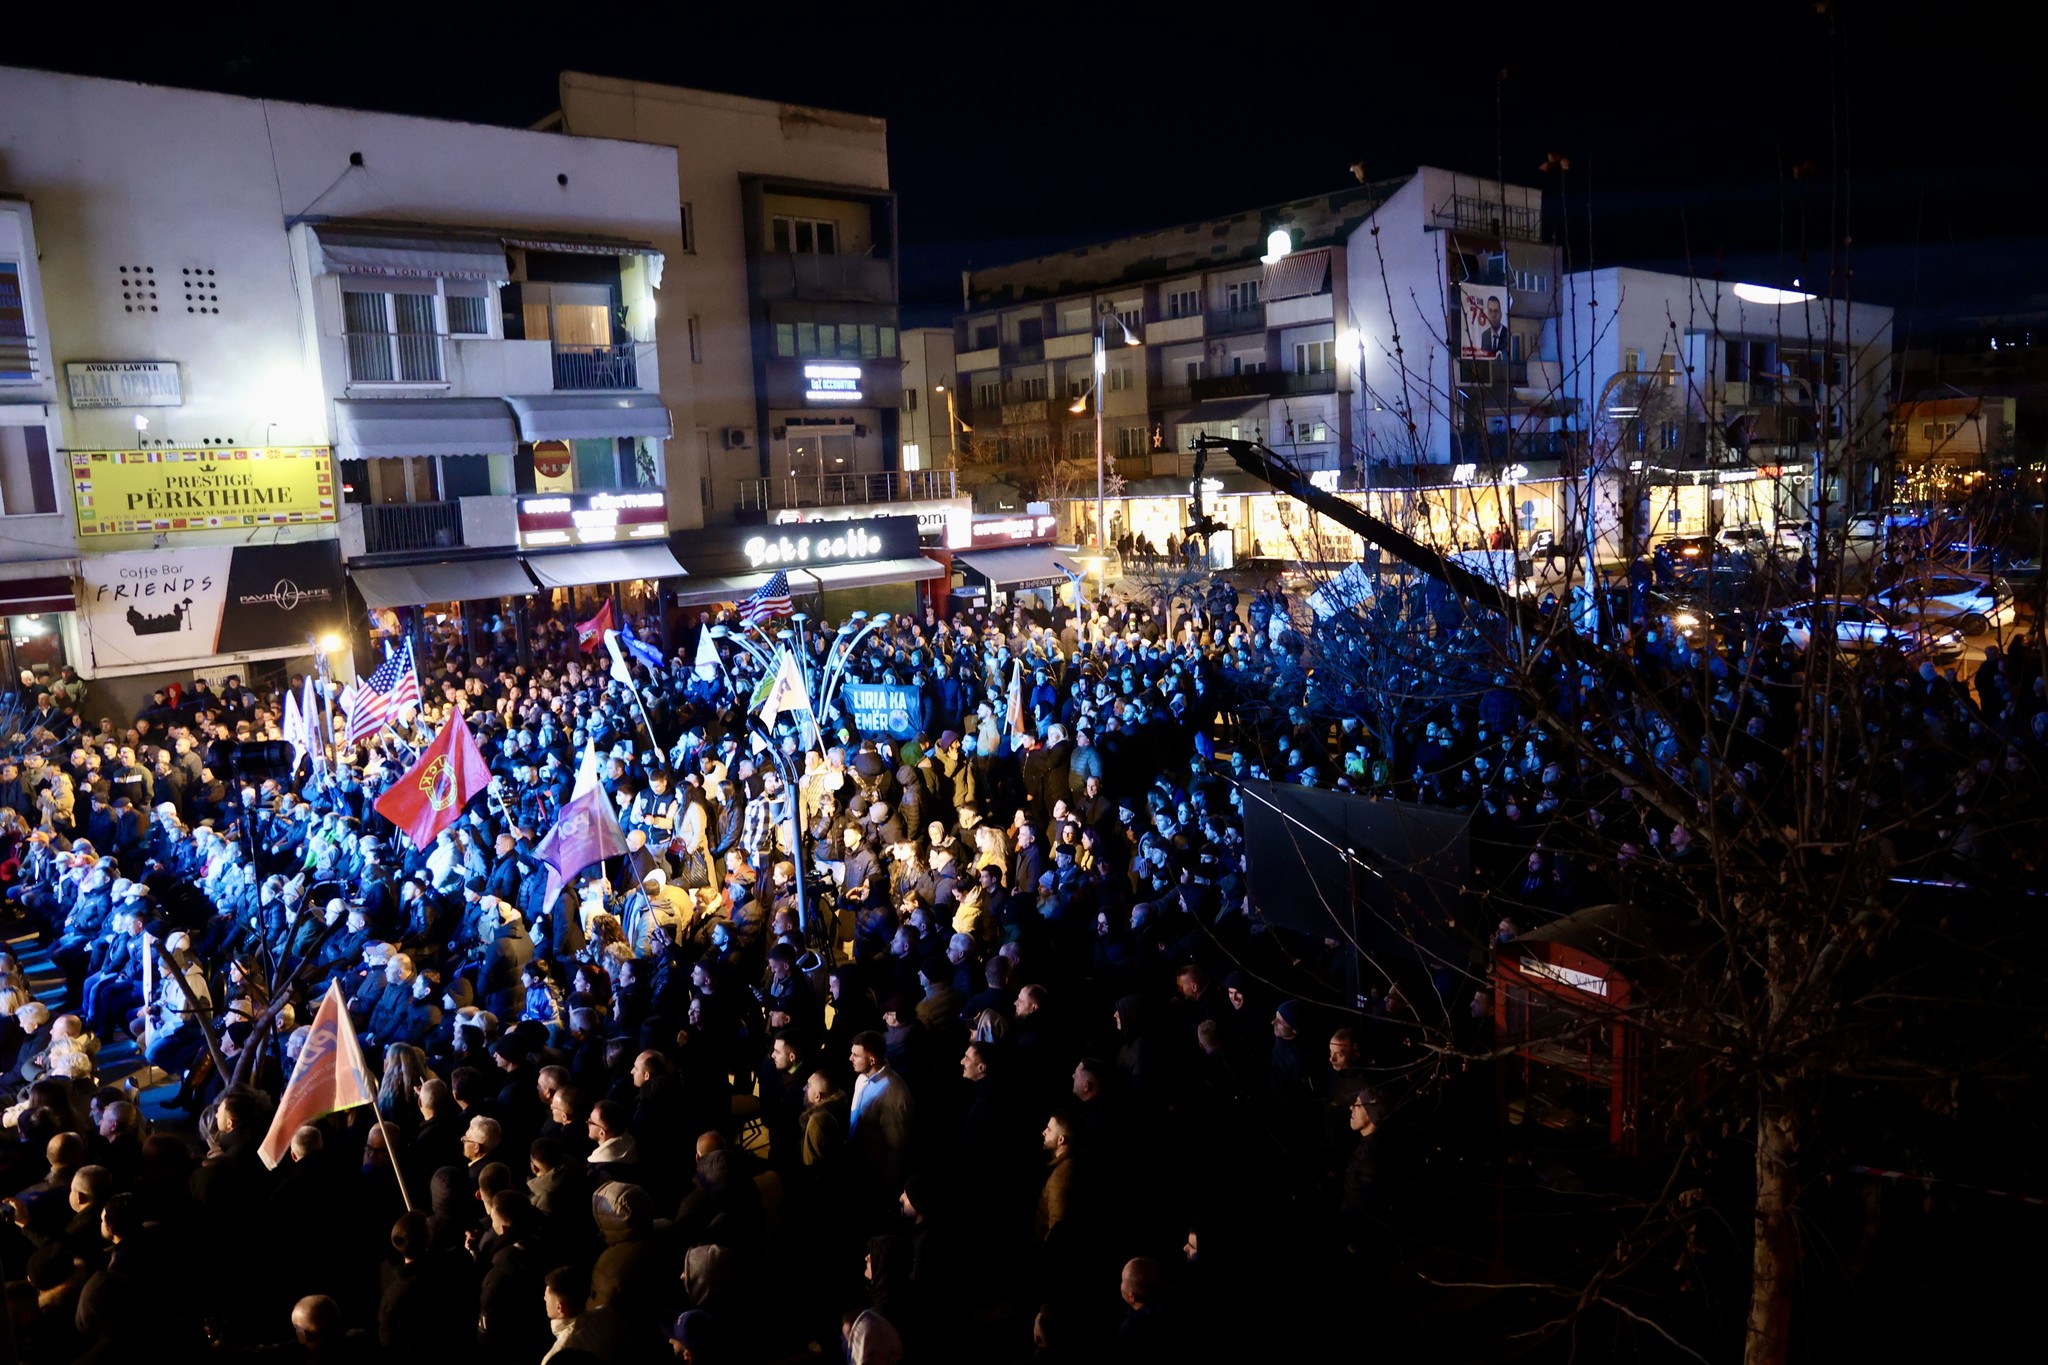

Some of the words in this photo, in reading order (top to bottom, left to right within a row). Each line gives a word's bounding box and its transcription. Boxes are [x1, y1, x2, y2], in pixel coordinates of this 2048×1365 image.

[348, 266, 387, 275] TENDA
[395, 268, 422, 277] LONI
[428, 270, 444, 278] 044
[70, 374, 113, 397] ELMI
[166, 474, 253, 489] PRESTIGE
[127, 486, 293, 511] PËRKTHIME
[119, 566, 158, 580] Caffe
[162, 564, 184, 576] Bar
[97, 576, 212, 602] FRIENDS
[854, 691, 887, 710] LIRIA
[890, 692, 907, 710] KA
[854, 710, 889, 731] EMËR
